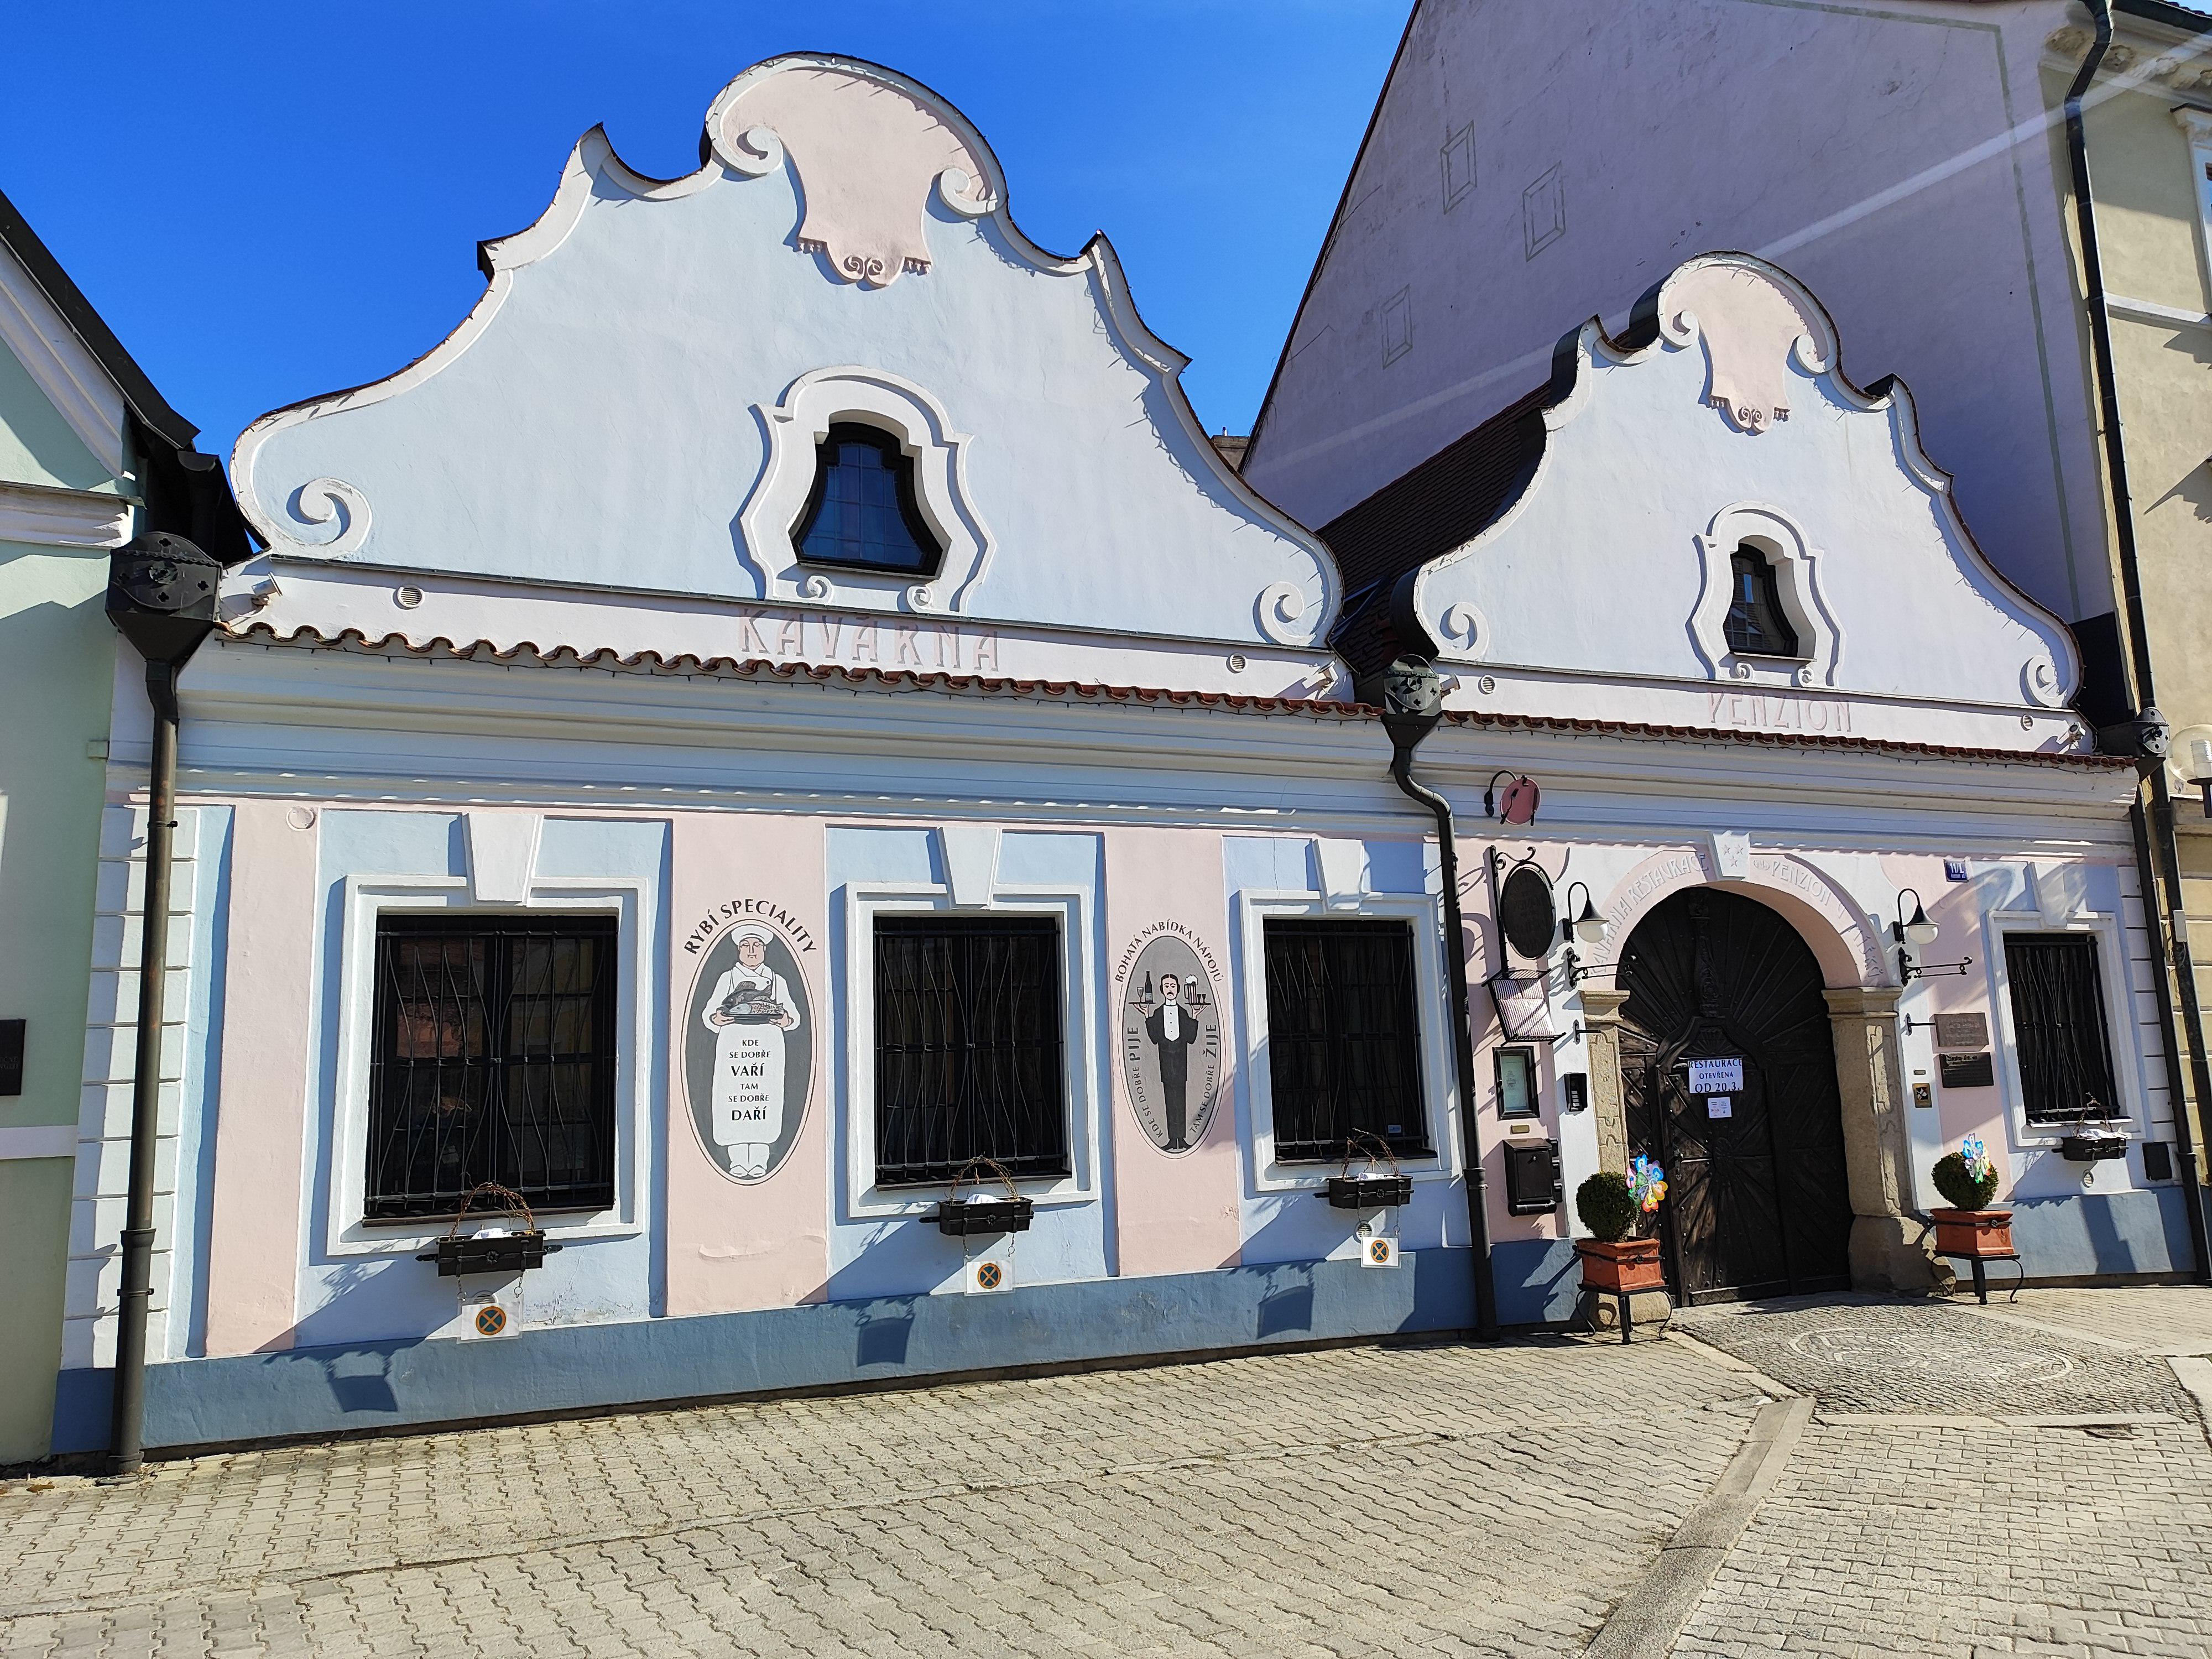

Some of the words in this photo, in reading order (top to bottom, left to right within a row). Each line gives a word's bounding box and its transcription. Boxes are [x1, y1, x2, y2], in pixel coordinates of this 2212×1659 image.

[738, 608, 999, 671] KAVÁRNA
[1628, 853, 1709, 905] RESTAURACE
[1771, 860, 1832, 906] PENZION
[684, 909, 719, 955] RYBÍ
[720, 899, 817, 953] SPECIALITY
[1115, 934, 1142, 983] BOHATÁ
[1141, 919, 1193, 940] NABÍDKA
[1127, 1027, 1141, 1061] PIJE
[1202, 1024, 1219, 1058] ŽIJE
[741, 1050, 771, 1058] DOBŘE
[1688, 1058, 1742, 1069] RESTAURACE
[731, 1062, 765, 1077] VAŘÍ
[1699, 1071, 1734, 1079] OTEVŘENA
[1131, 1067, 1146, 1103] DOBŘE
[1203, 1065, 1214, 1099] DOBŘE
[1694, 1083, 1712, 1093] OD
[1715, 1082, 1740, 1092] 20.3.
[740, 1093, 770, 1102] DOBŘE
[1199, 1101, 1208, 1113] SE
[732, 1106, 766, 1121] DAŘÍ
[1141, 1105, 1152, 1117] SE
[1148, 1118, 1164, 1138] KDE
[1190, 1114, 1204, 1134] TAM
